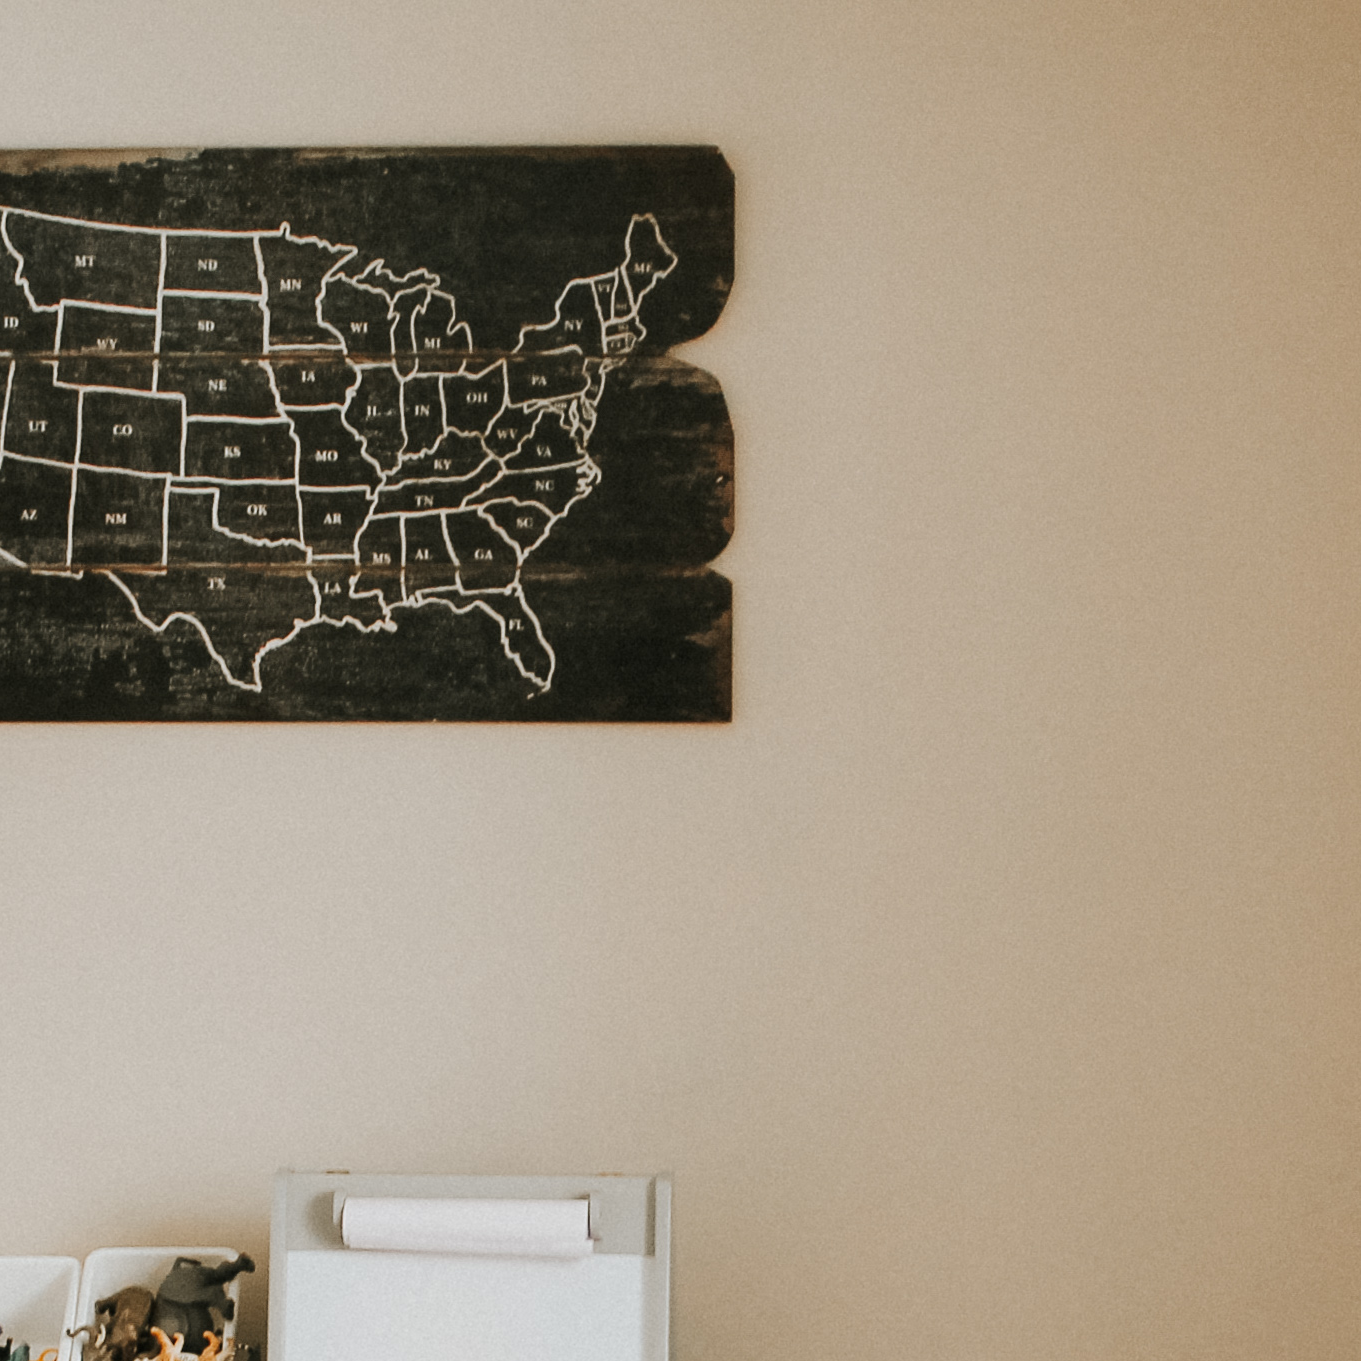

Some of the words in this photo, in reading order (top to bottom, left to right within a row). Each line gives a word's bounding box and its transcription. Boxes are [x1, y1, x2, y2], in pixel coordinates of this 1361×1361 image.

[74, 254, 96, 268] MT
[197, 258, 218, 272] ND
[279, 278, 302, 292] MN
[596, 282, 612, 295] VT
[3, 316, 19, 329] ID
[197, 320, 215, 332] SD
[350, 321, 368, 334] WI
[564, 319, 583, 331] NY
[95, 338, 118, 351] WY
[424, 337, 441, 349] MI
[301, 370, 316, 383] IA
[531, 374, 547, 386] PA
[208, 378, 227, 391] NE
[466, 392, 488, 403] OH
[414, 404, 430, 417] IN
[28, 420, 48, 433] UT
[112, 424, 133, 436] CO
[496, 428, 516, 440] WV
[224, 445, 241, 458] KS
[315, 450, 339, 462] MO
[536, 445, 552, 458] VA
[433, 458, 452, 471] KY
[535, 479, 555, 492] NC
[415, 495, 435, 508] TN
[20, 509, 37, 521] AZ
[246, 504, 268, 516] OK
[105, 512, 127, 525] NM
[323, 512, 342, 525] AR
[372, 552, 391, 565] MS
[415, 548, 433, 561] AL
[474, 548, 493, 561] GA
[207, 576, 226, 591] TX
[323, 581, 342, 595] LA
[508, 618, 525, 632] FL
